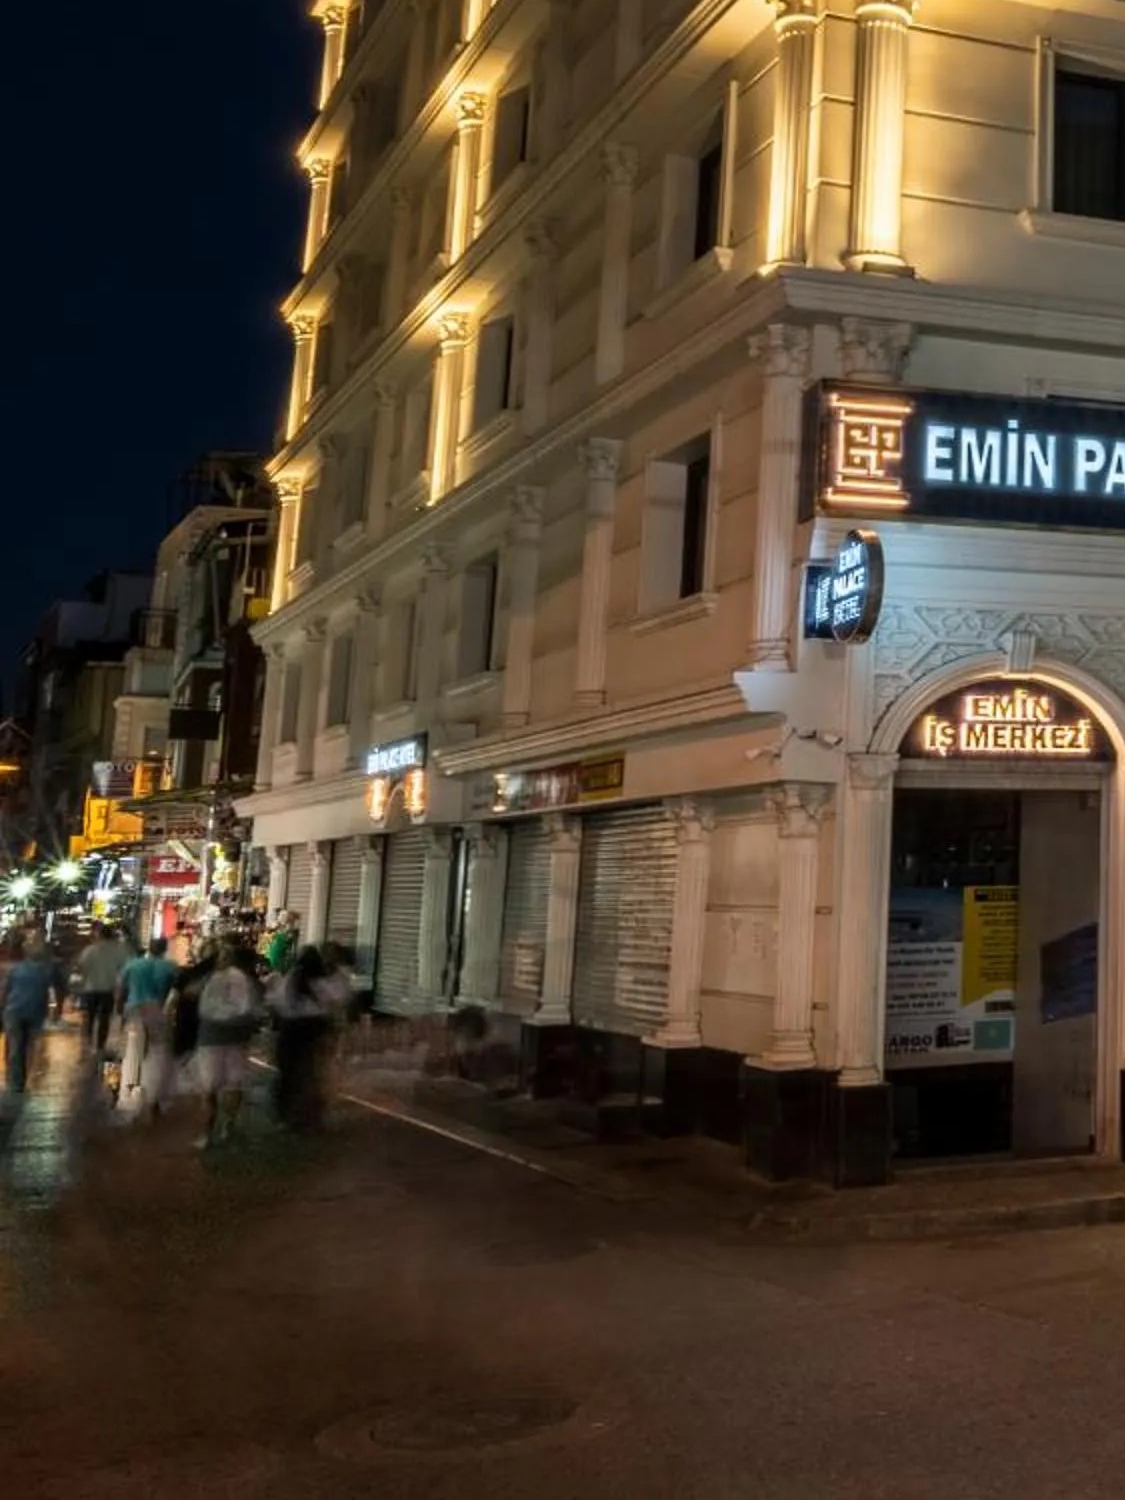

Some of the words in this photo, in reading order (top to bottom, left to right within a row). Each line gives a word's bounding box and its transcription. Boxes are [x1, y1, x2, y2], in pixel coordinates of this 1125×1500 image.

[923, 419, 1056, 488] EMİN
[967, 689, 1053, 721] EMİN
[963, 719, 1091, 752] MERKEZİ
